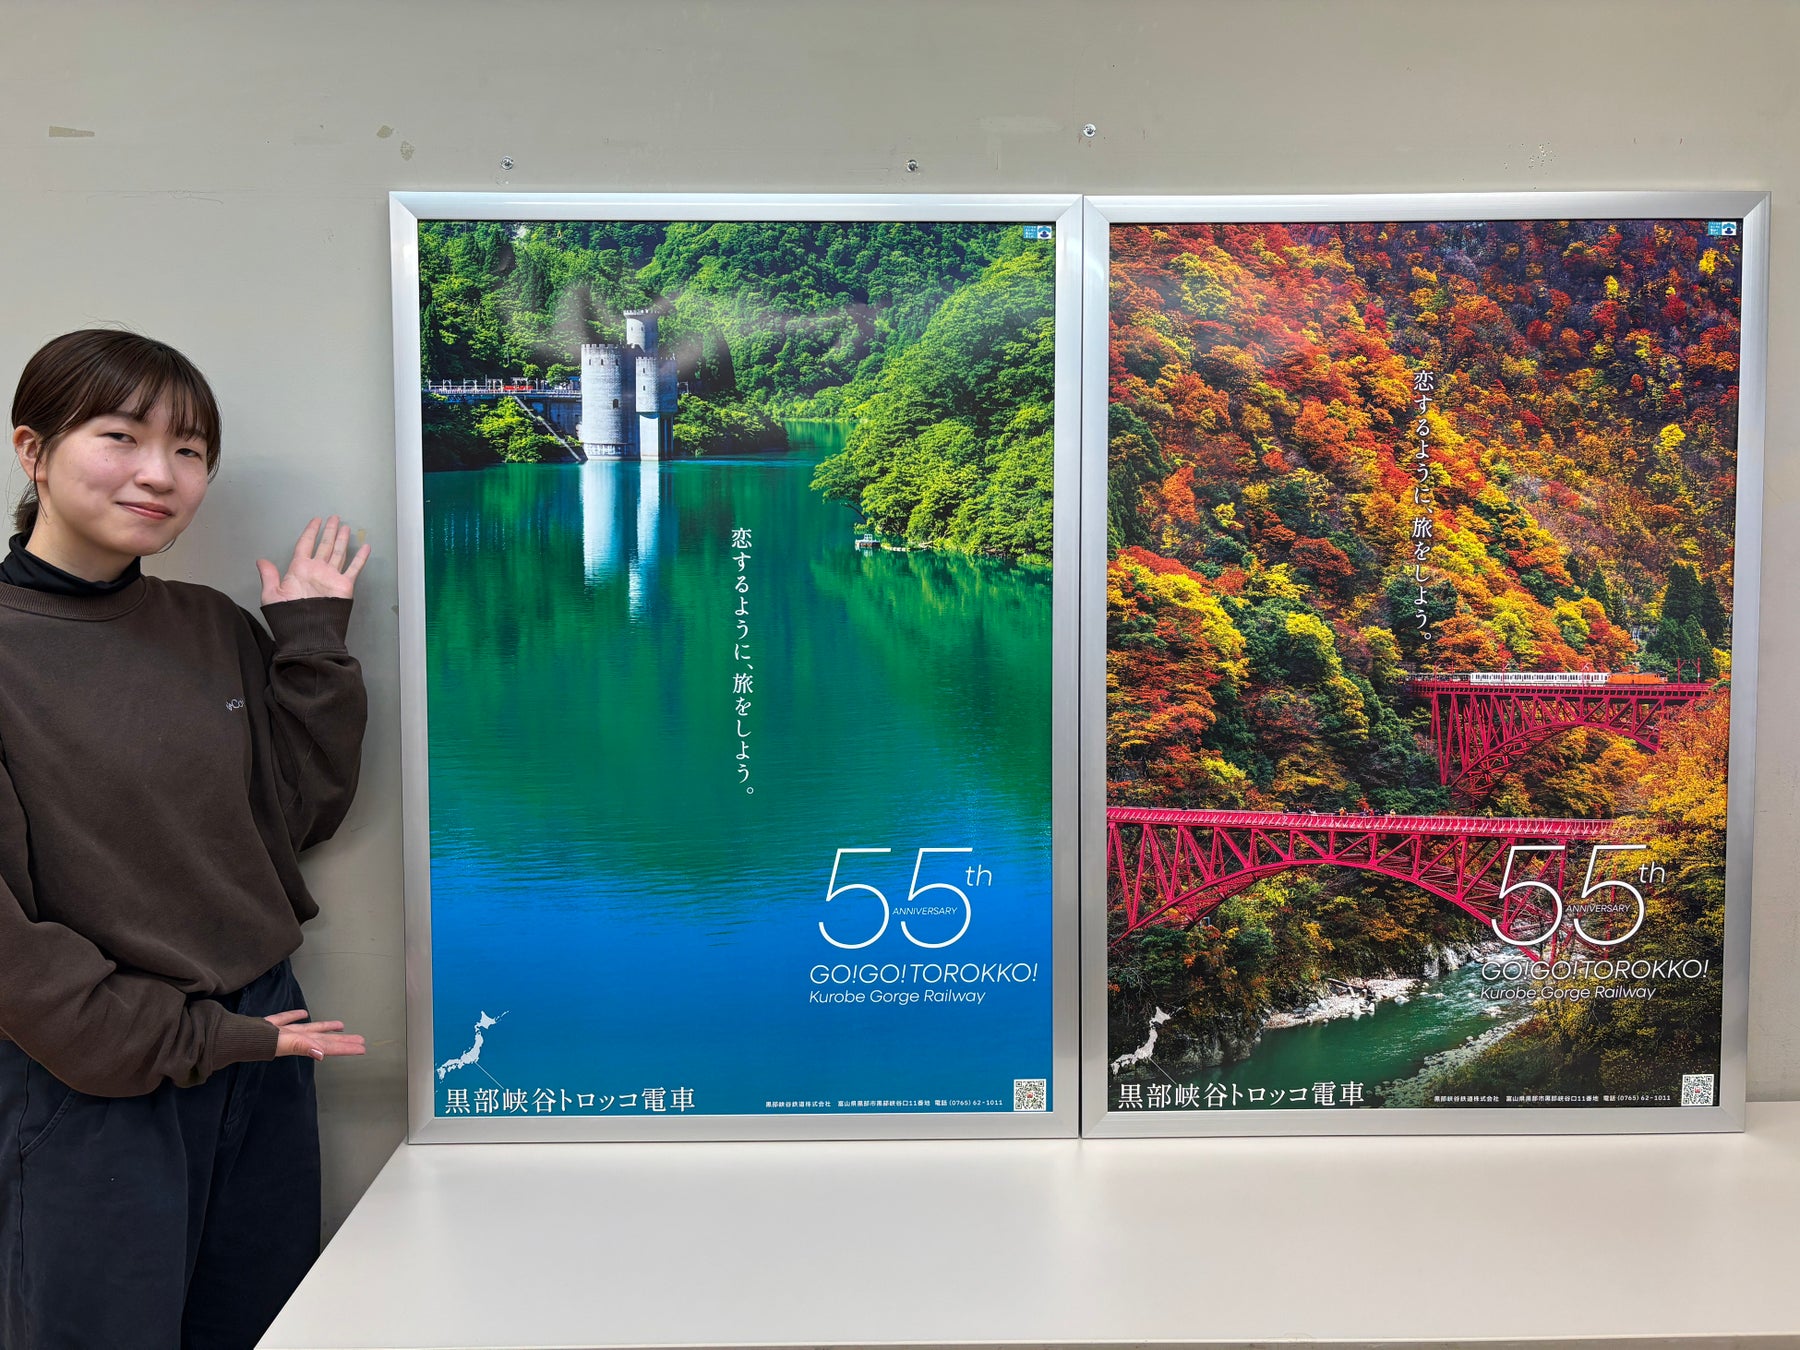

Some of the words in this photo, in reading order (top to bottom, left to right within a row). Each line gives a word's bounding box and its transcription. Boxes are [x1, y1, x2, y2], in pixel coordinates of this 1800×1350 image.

[1412, 370, 1433, 641] 恋するように、旅をしよう。
[731, 527, 754, 795] 恋するように、旅をしよう。
[892, 906, 958, 916] ANNIVERSARY
[1566, 904, 1631, 913] ANNIVERSARY
[809, 990, 866, 1004] Kurobe
[869, 990, 920, 1006] Gorge
[924, 989, 986, 1005] Railway
[1480, 986, 1537, 1000] Kurobe
[1541, 986, 1591, 1001] Gorge
[1595, 985, 1656, 1001] Railway
[445, 1087, 695, 1114] 黒部峡谷トロッコ電車
[1118, 1081, 1364, 1109] 黒部峡谷トロッコ電車
